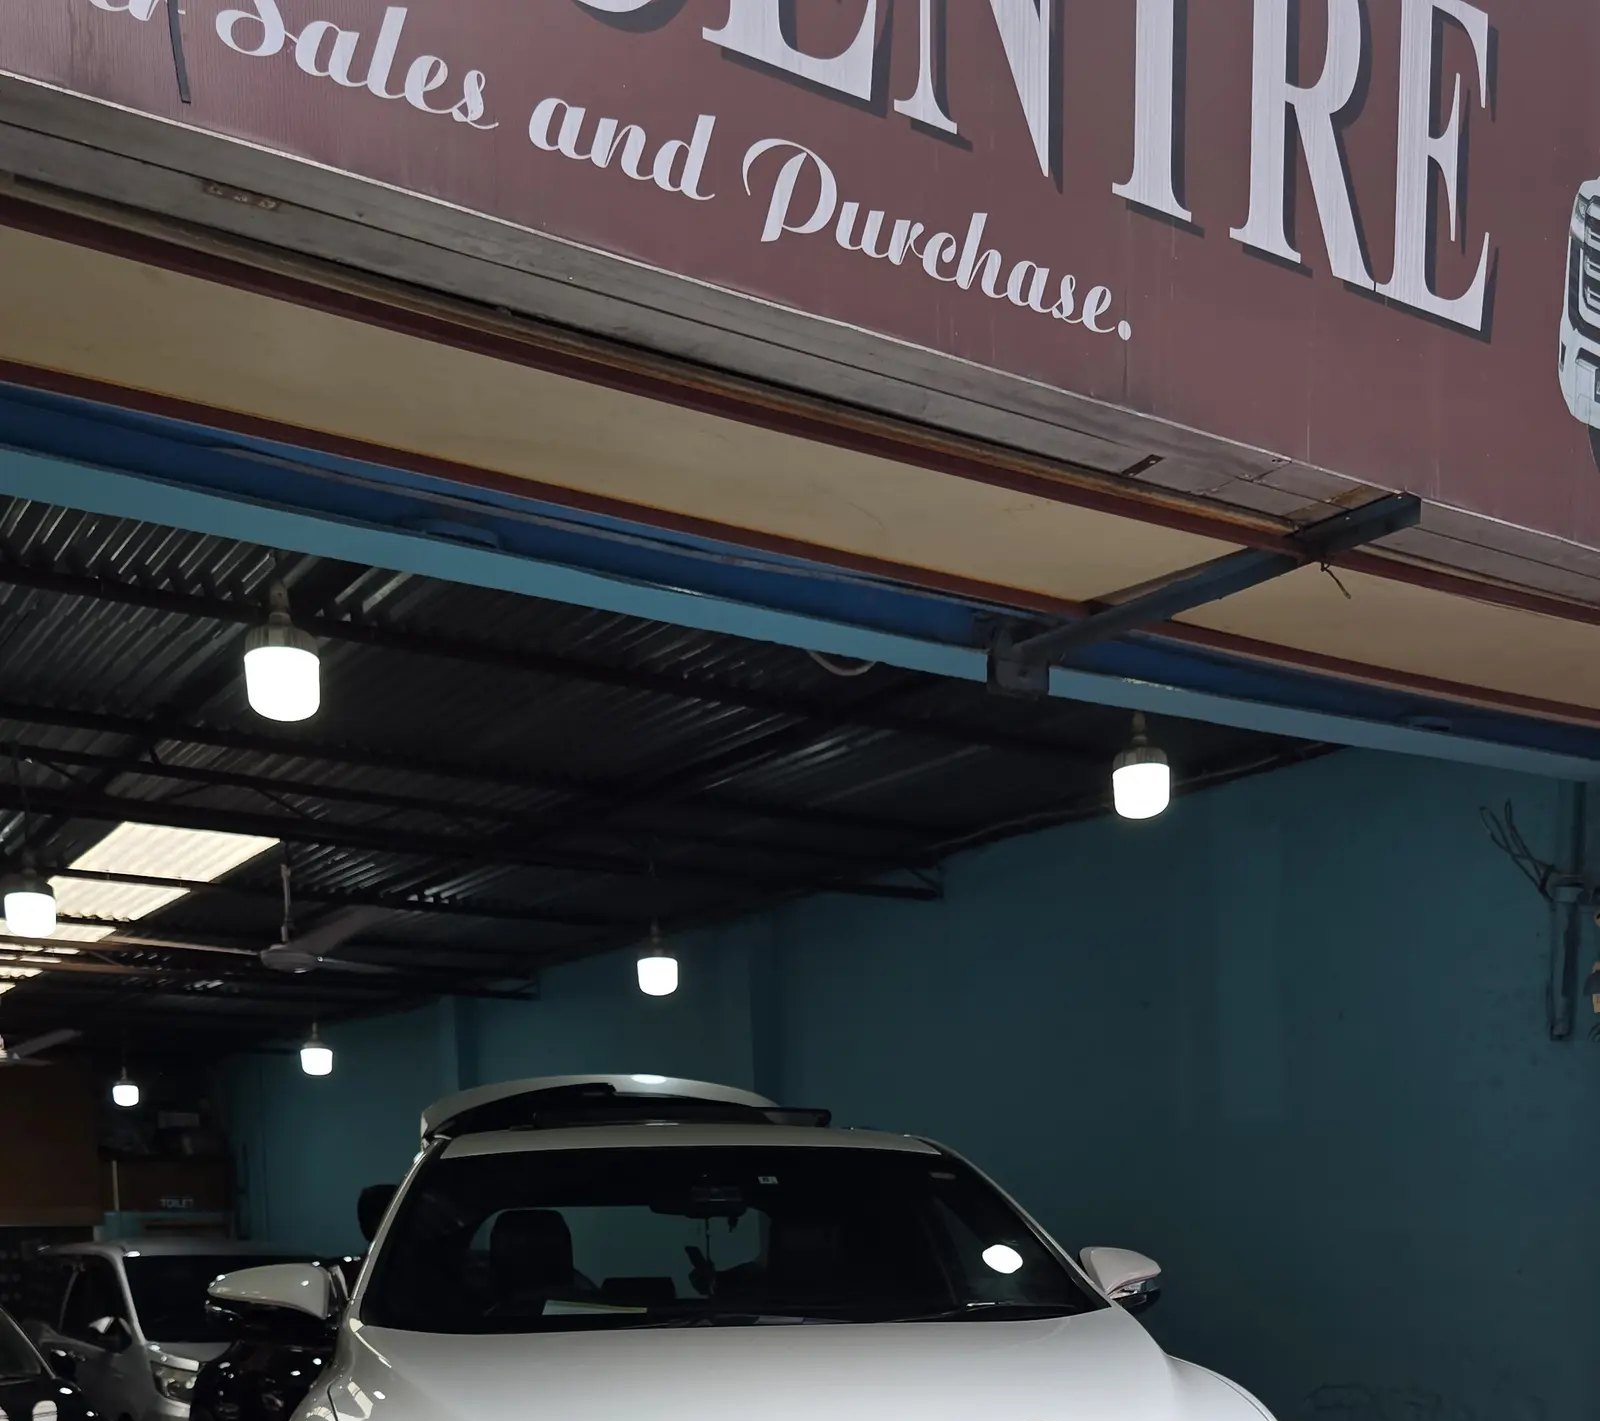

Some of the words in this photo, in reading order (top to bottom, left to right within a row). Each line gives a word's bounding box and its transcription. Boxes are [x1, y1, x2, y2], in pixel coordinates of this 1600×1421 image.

[215, 0, 499, 130] Sales
[528, 97, 716, 201] and
[741, 138, 1132, 342] Purchase.
[574, 0, 1490, 332] NTRE
